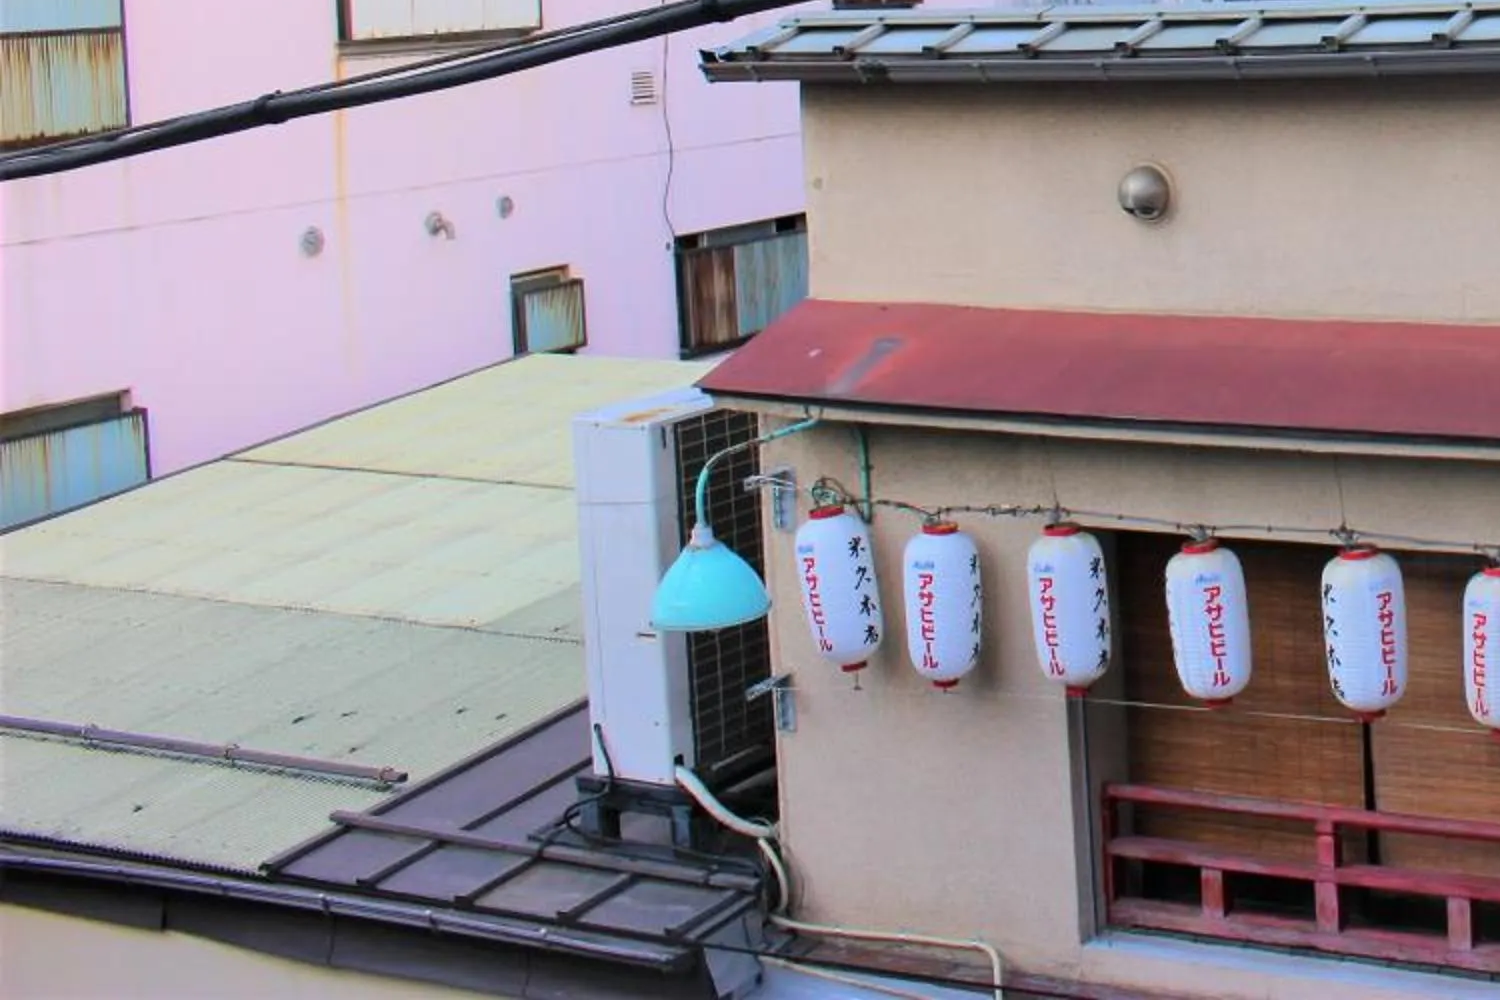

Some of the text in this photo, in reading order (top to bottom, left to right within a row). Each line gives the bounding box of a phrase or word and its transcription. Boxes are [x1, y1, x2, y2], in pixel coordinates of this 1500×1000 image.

[802, 557, 833, 653] アサヒビール
[918, 573, 939, 669] アサヒビール
[1038, 577, 1065, 676] アサヒビール
[1203, 585, 1231, 687] アサヒビール
[1375, 591, 1398, 697] アサヒビール
[1471, 612, 1489, 717] アサヒビール
